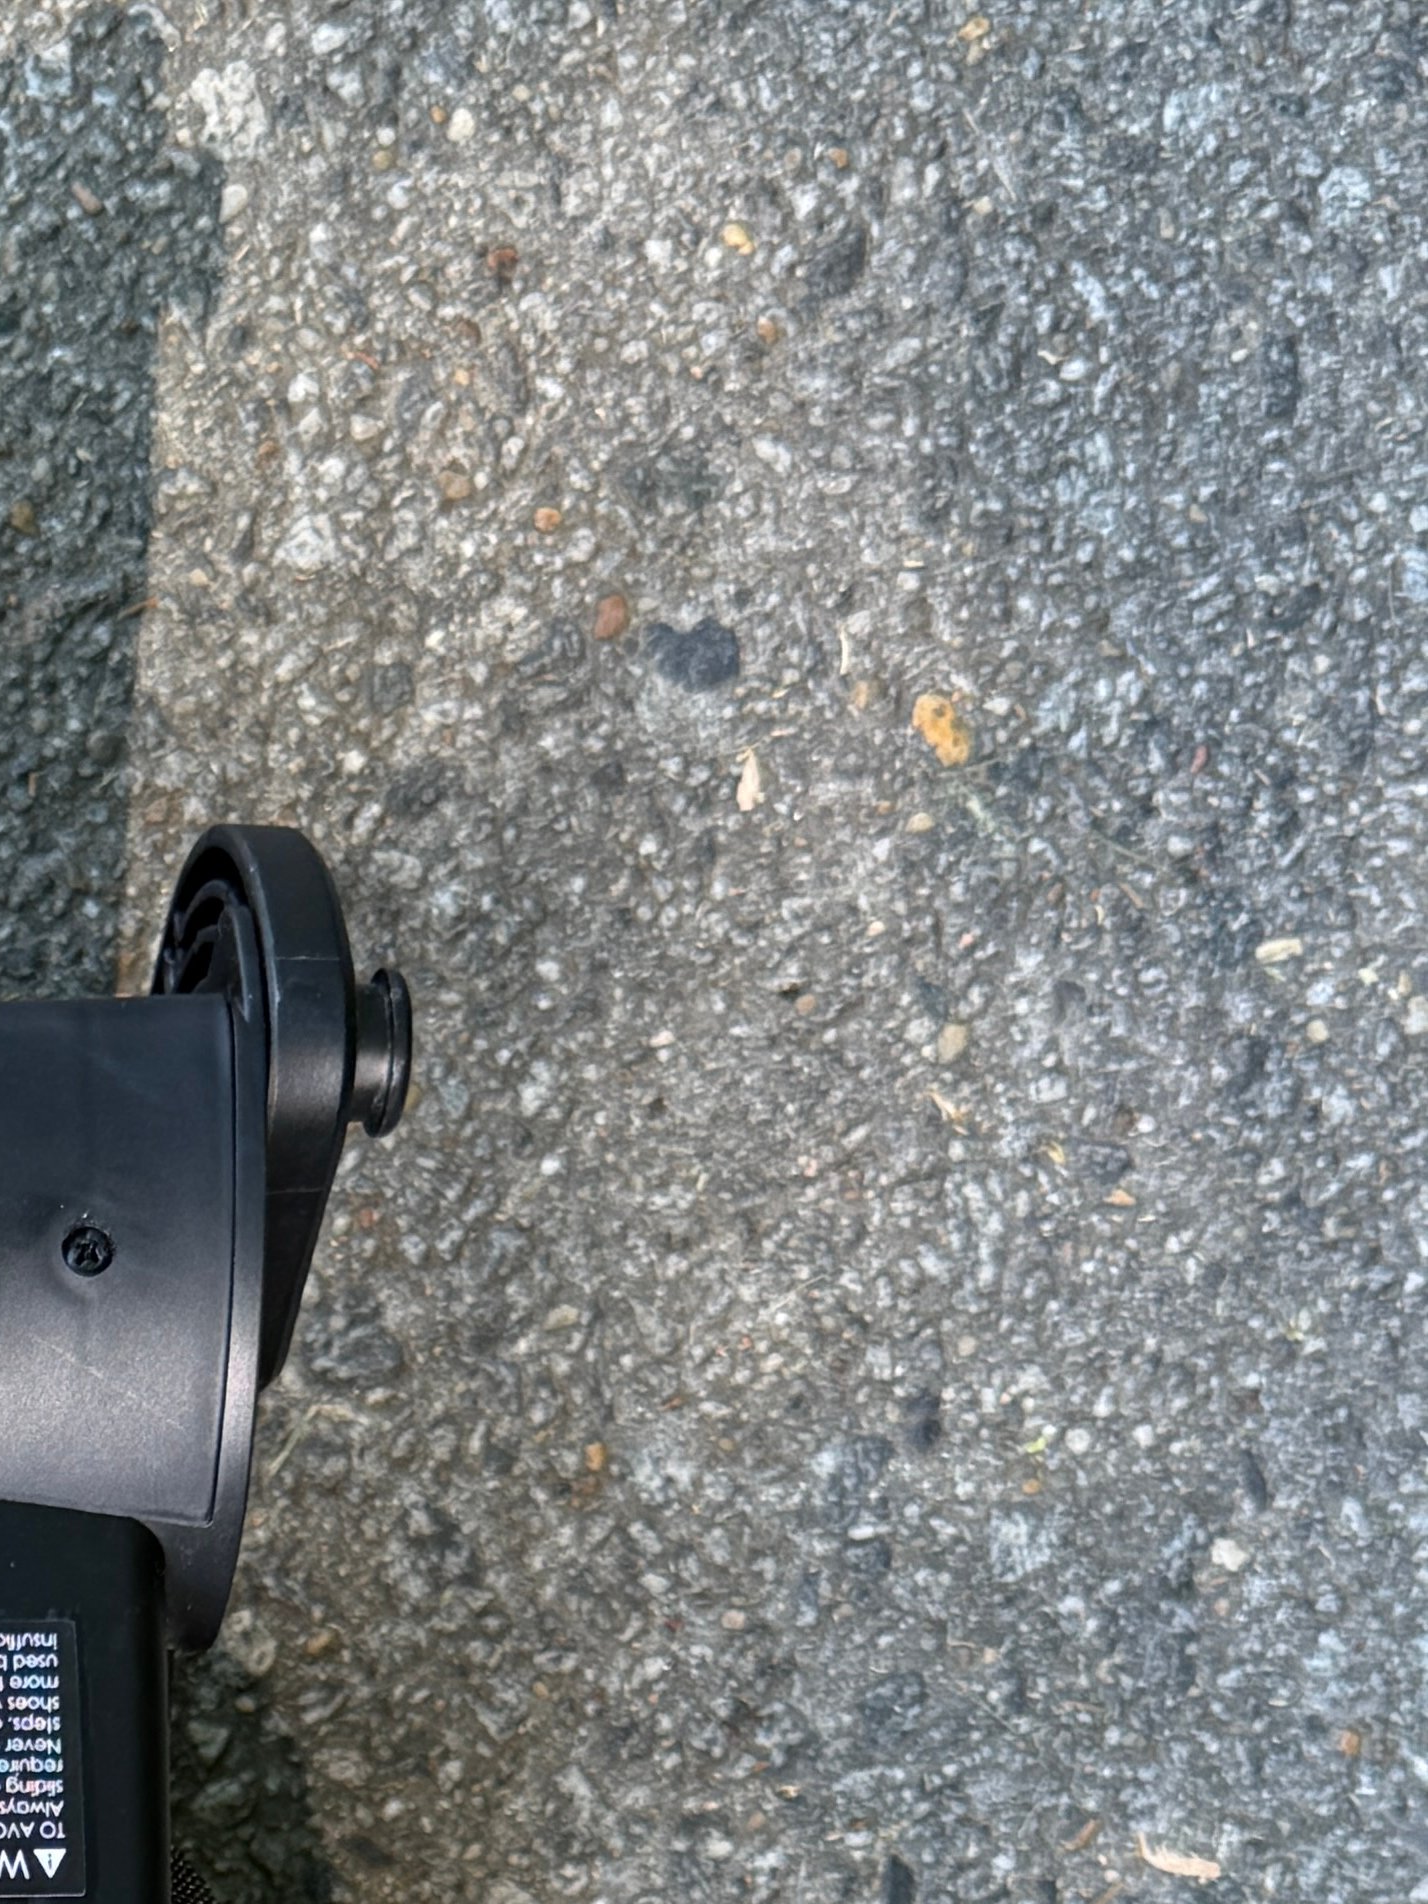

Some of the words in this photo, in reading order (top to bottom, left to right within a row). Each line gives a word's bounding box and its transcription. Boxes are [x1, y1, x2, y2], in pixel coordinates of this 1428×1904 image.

[13, 1653, 59, 1670] used
[9, 1675, 59, 1688] more
[7, 1695, 60, 1712] shoes
[4, 1737, 61, 1754] Never
[5, 1775, 63, 1795] sliding
[39, 1820, 65, 1837] TO
